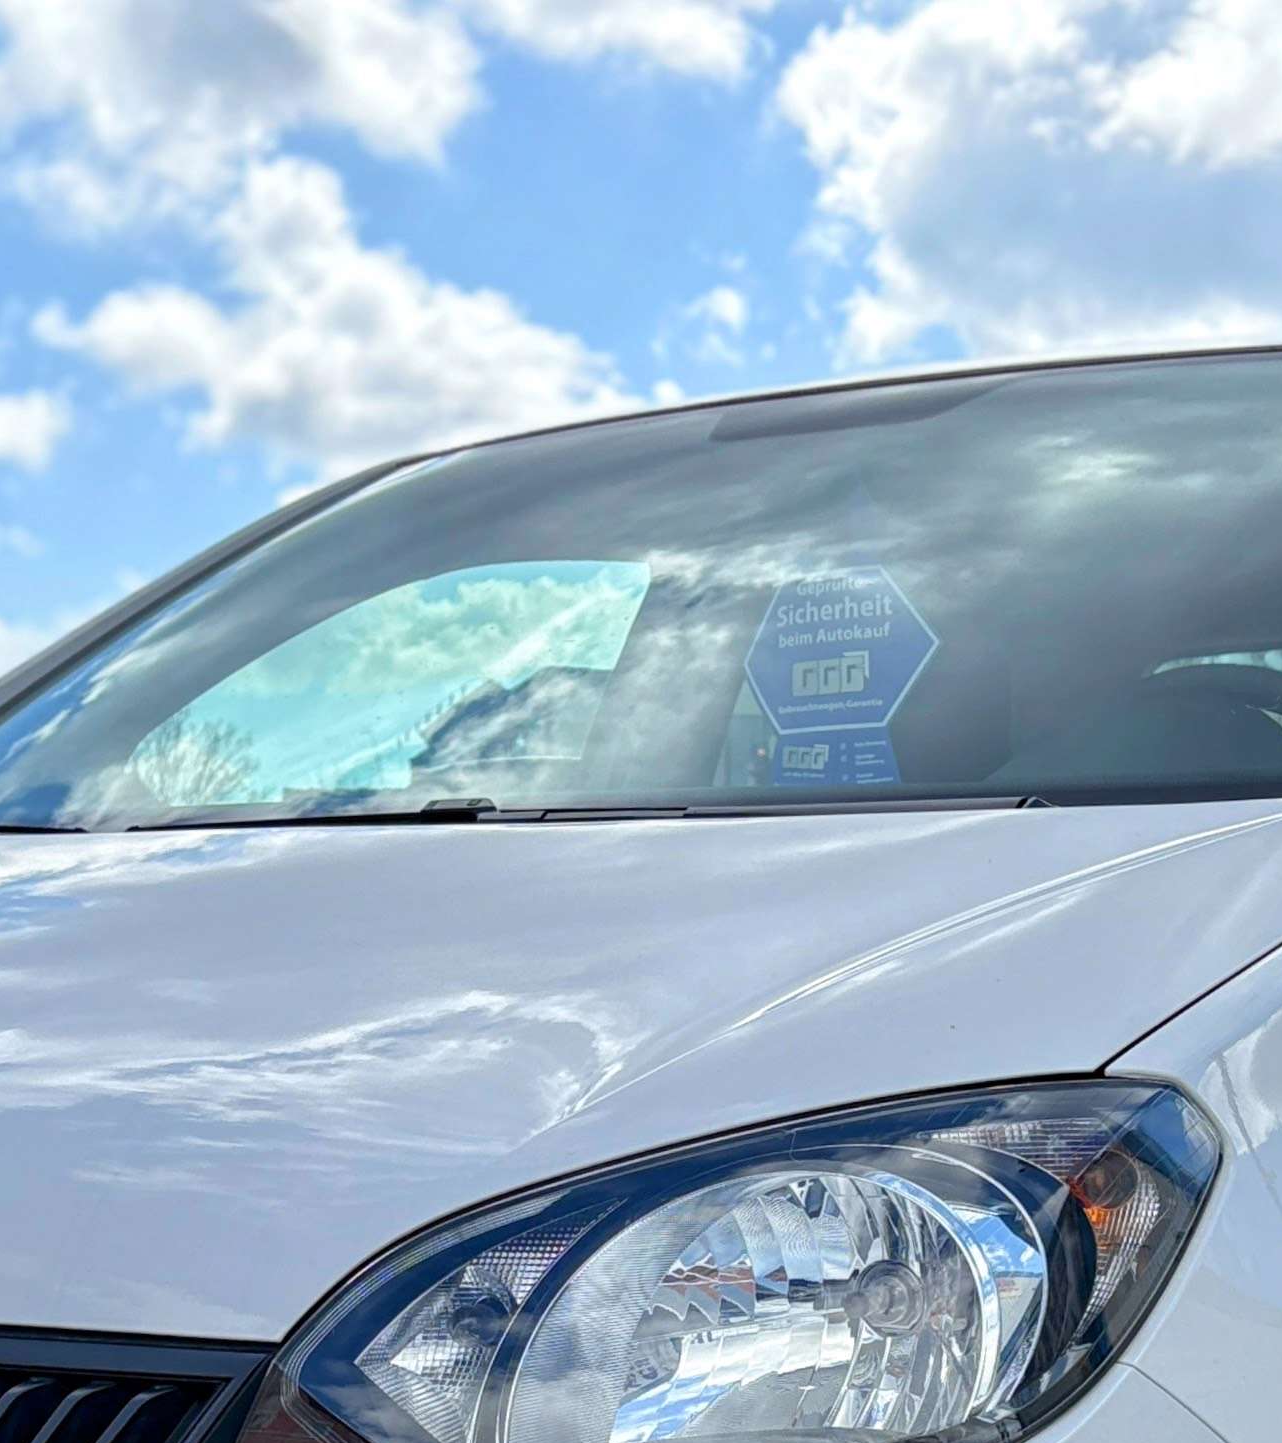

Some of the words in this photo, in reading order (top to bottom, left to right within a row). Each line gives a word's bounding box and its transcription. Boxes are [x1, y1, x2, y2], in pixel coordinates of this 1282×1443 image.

[776, 593, 893, 628] Sicherheit
[778, 632, 813, 649] beim
[816, 621, 891, 643] Autokauf
